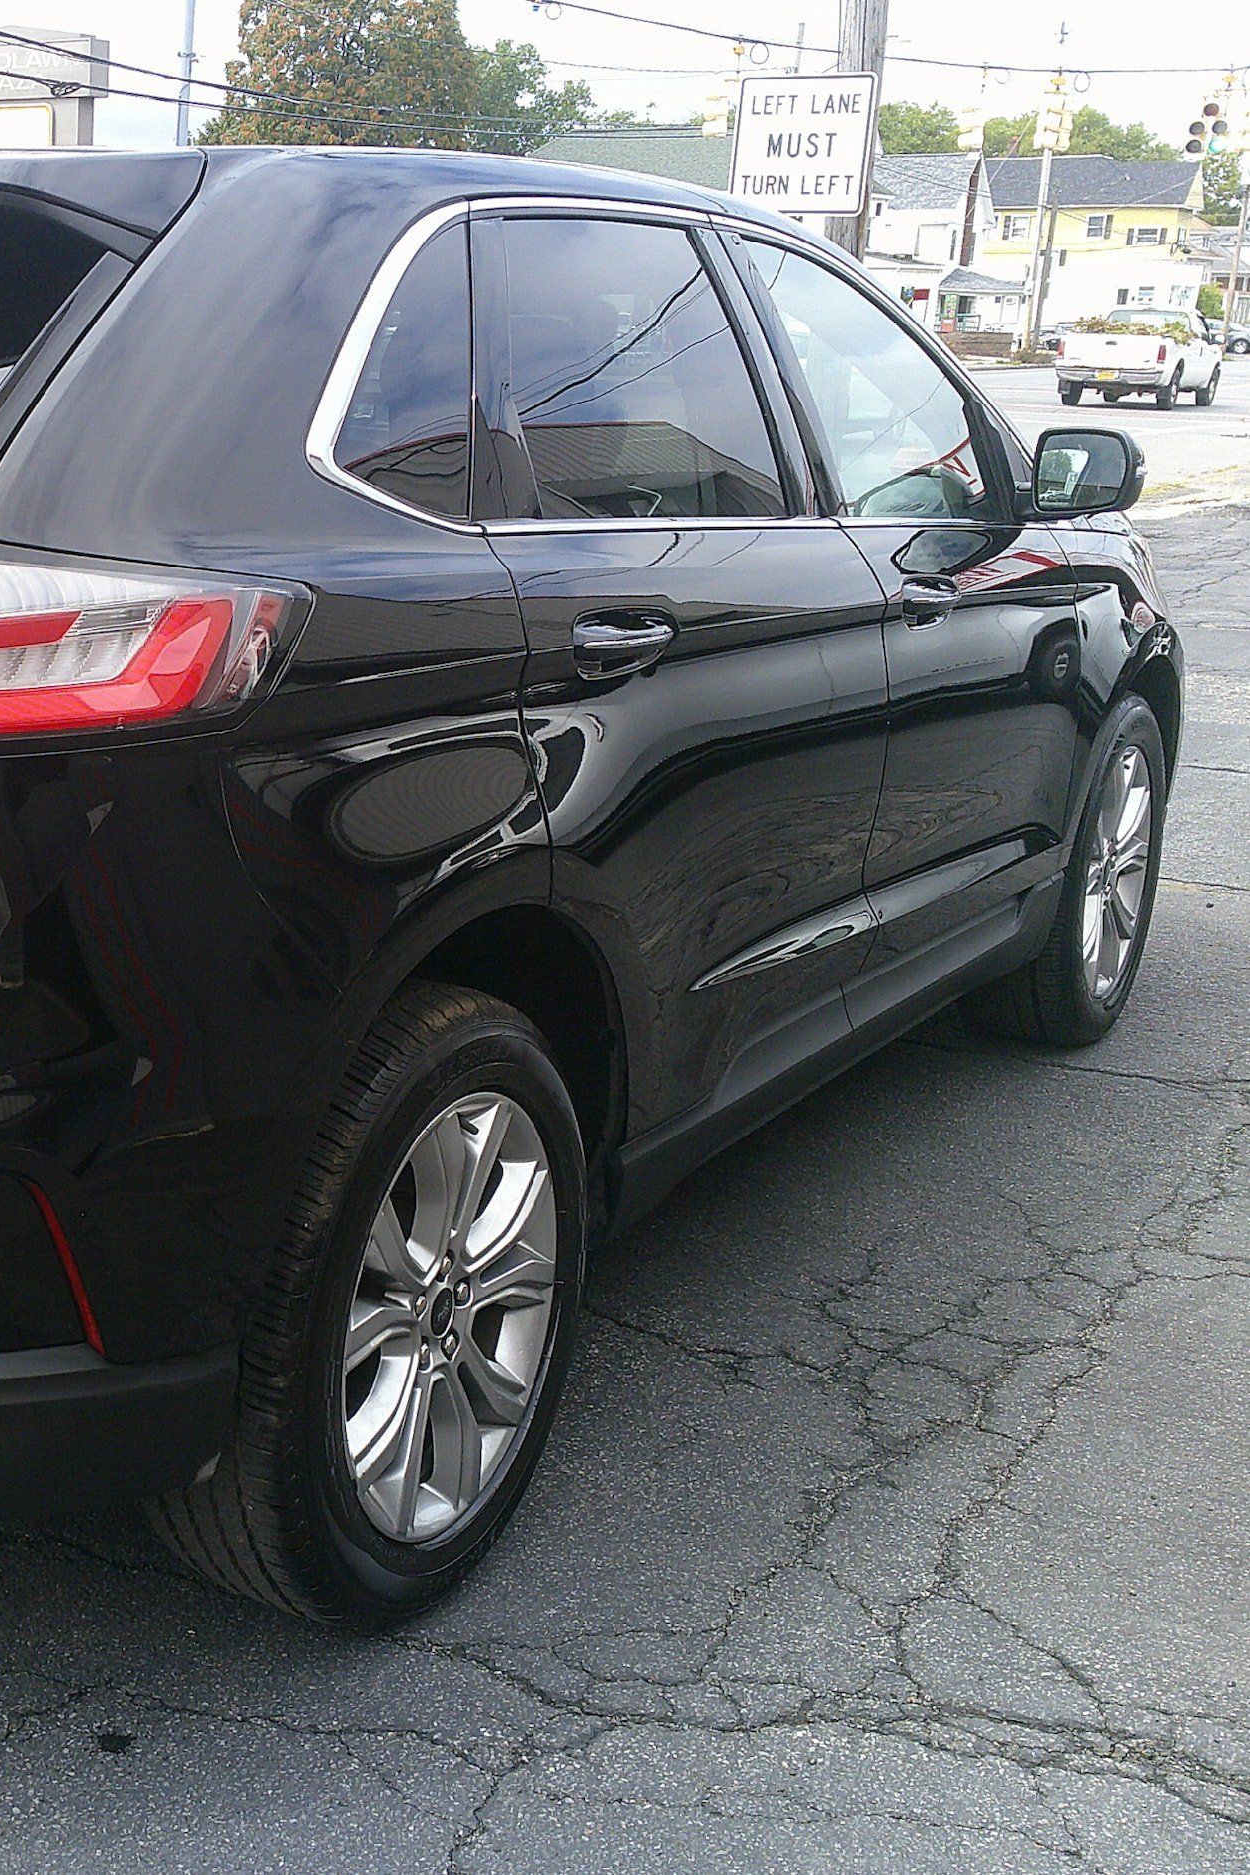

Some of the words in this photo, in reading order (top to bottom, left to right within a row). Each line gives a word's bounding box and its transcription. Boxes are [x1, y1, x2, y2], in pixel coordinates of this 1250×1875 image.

[752, 94, 798, 115] LEFT
[811, 93, 862, 114] LANE
[766, 133, 837, 158] MUST
[742, 175, 789, 195] TURN
[800, 175, 854, 195] LEFT
